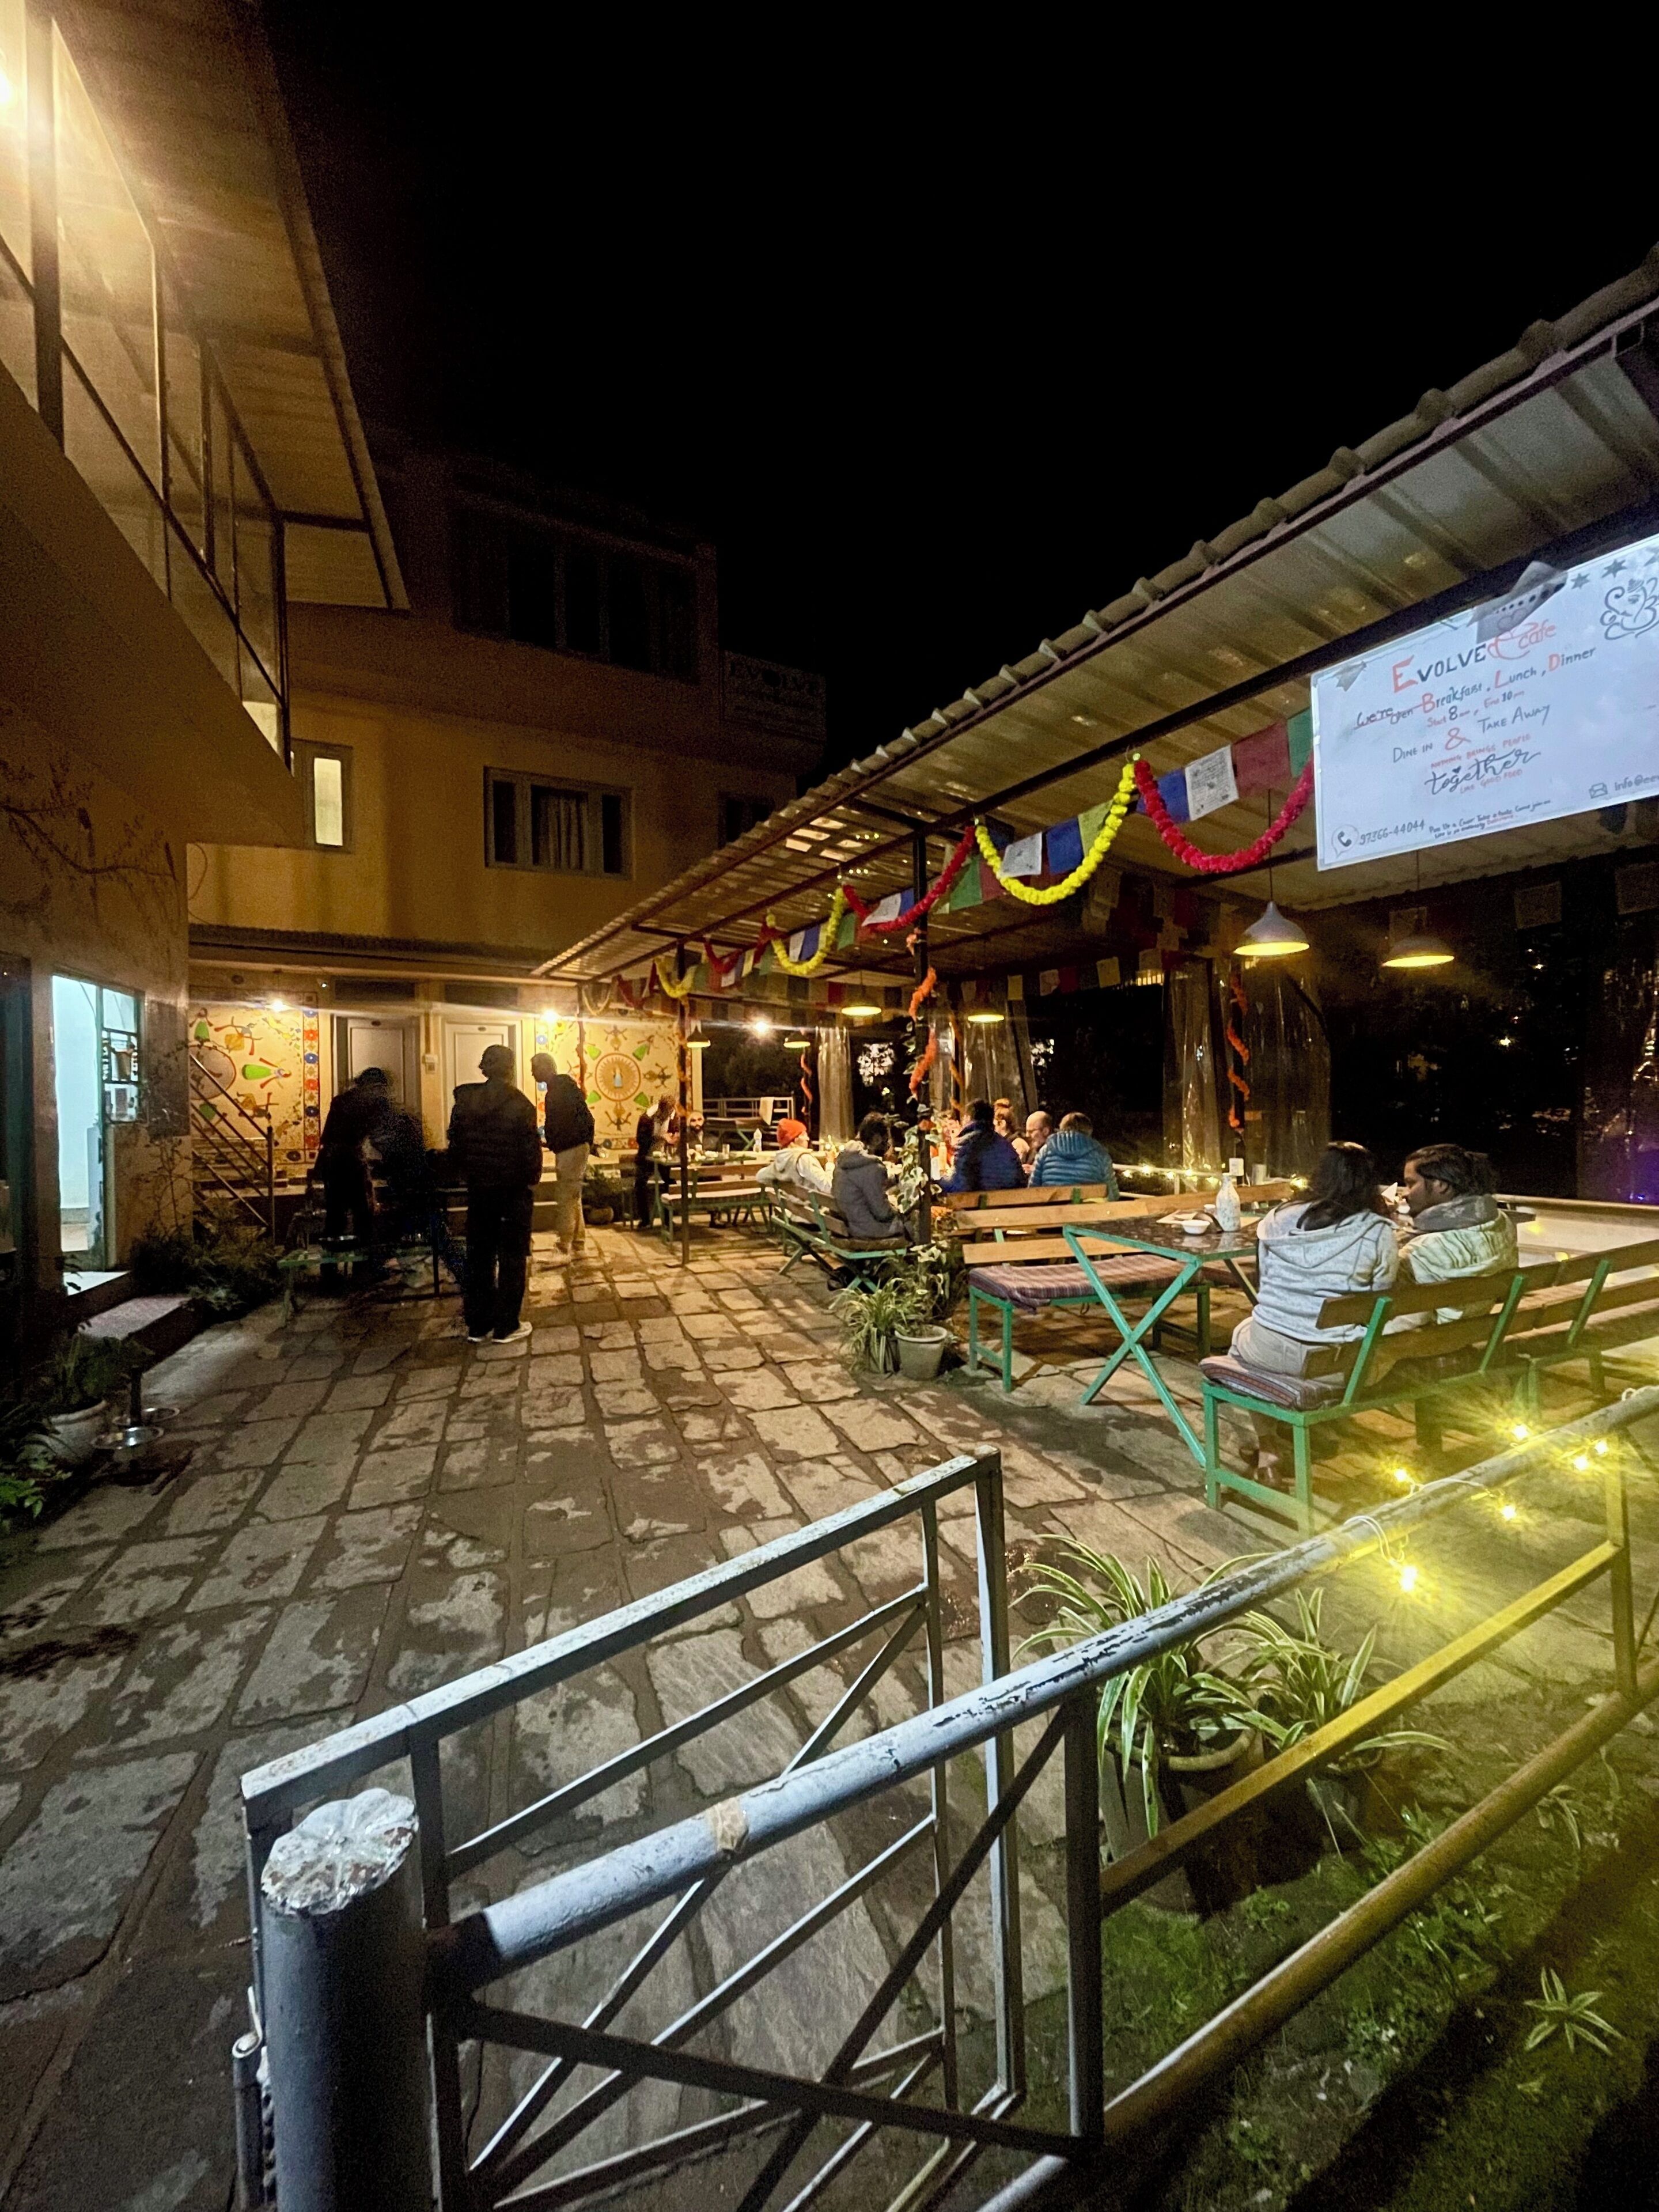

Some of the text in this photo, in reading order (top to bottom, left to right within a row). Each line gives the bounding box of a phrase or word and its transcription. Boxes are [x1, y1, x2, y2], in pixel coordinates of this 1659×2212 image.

[1392, 643, 1486, 692] EVOLVE
[1548, 647, 1596, 672] Dinner
[1422, 743, 1433, 752] IN
[1444, 727, 1472, 751] &
[1424, 748, 1541, 796] together
